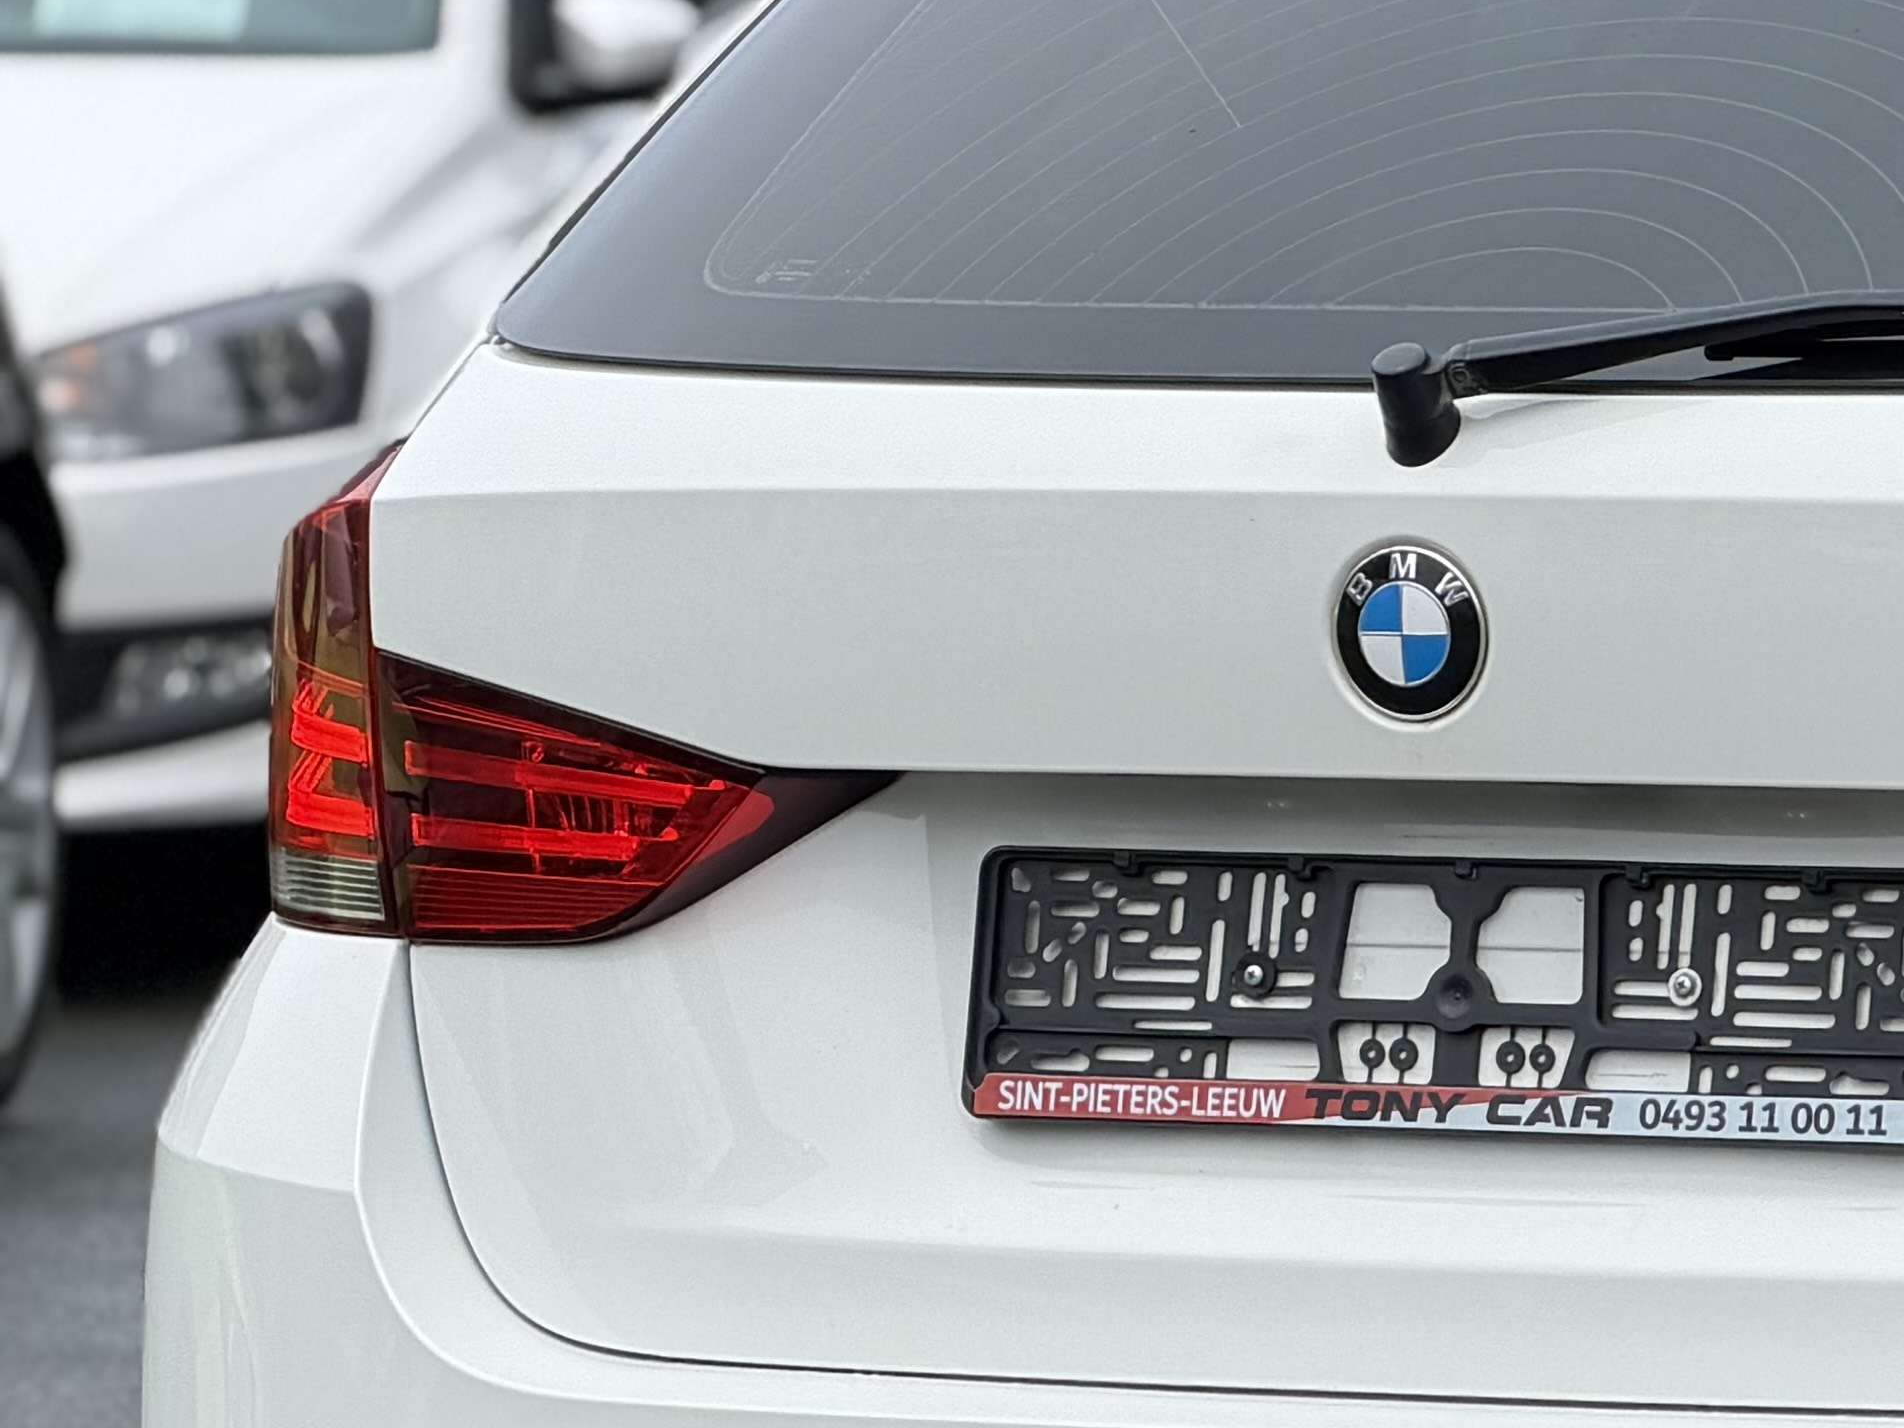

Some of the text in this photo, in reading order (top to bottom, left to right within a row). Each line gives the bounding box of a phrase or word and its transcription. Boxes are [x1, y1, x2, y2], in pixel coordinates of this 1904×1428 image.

[1347, 552, 1470, 607] BMW
[997, 1080, 1887, 1136] SINT-PIETERS-LEEUW TONY CAR 0493 11 00 11
